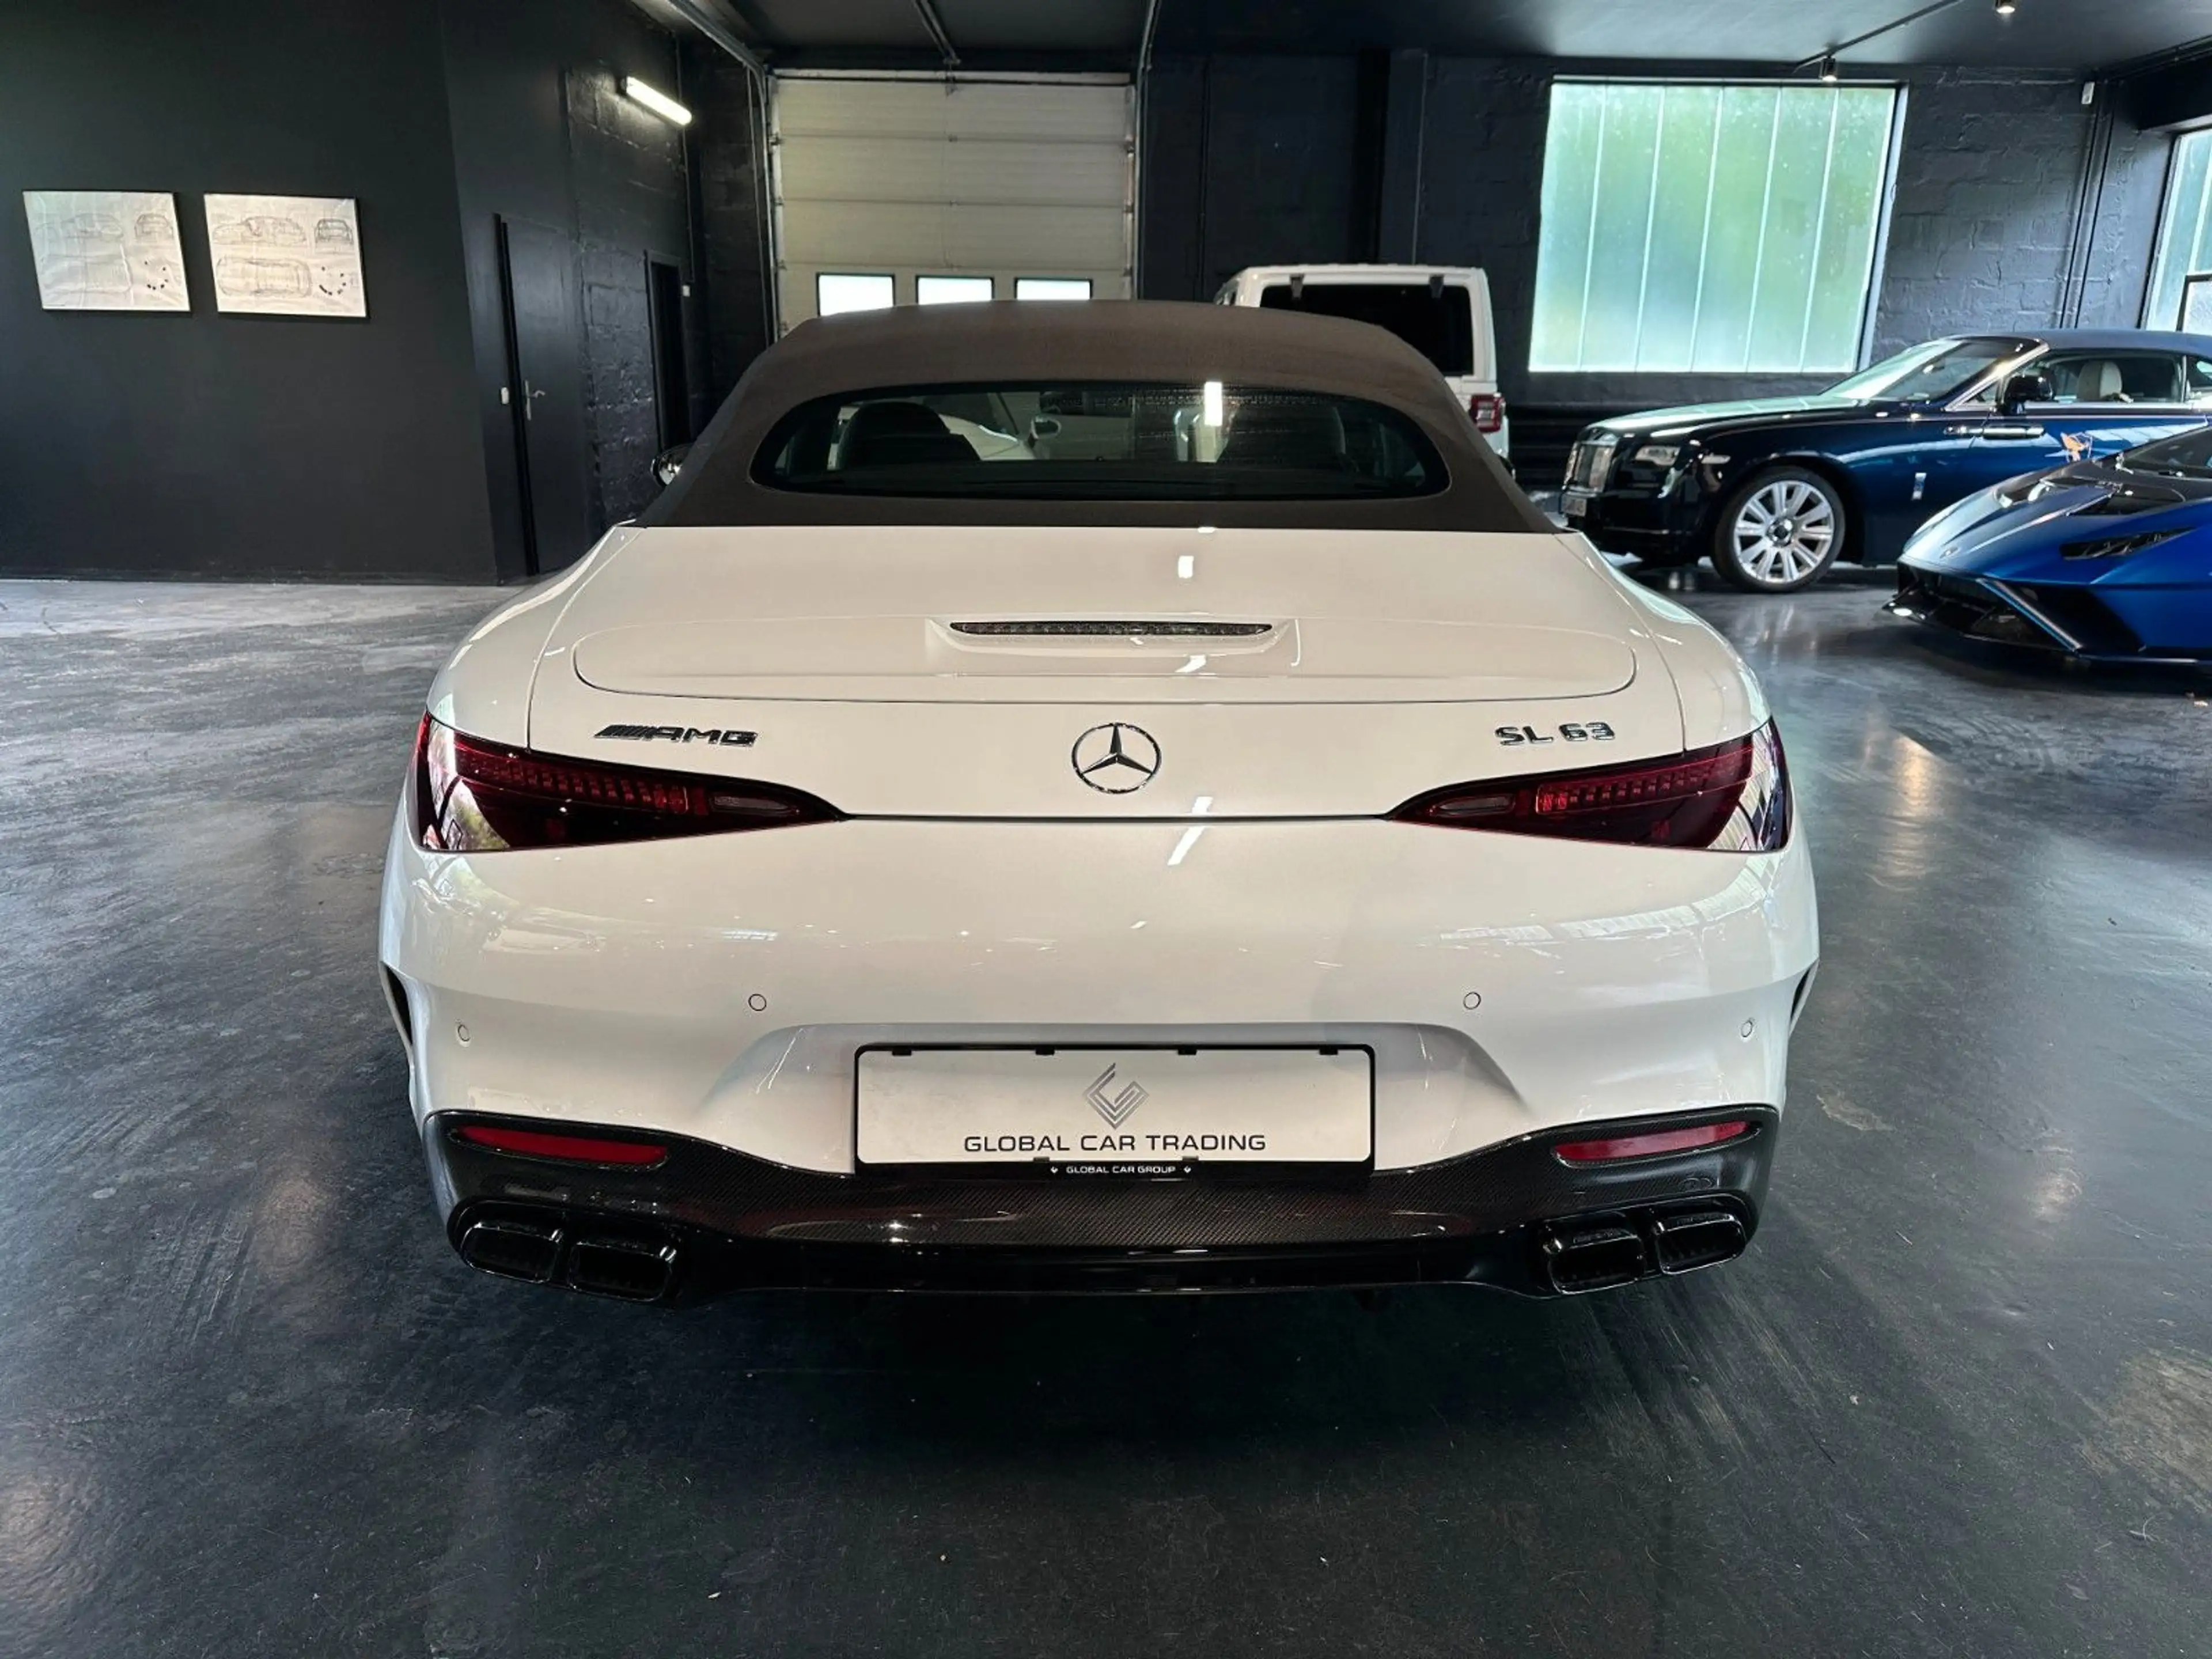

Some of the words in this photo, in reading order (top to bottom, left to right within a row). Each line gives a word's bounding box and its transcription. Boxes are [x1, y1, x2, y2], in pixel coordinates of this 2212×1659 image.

[639, 724, 757, 747] AMG
[1495, 726, 1554, 745] SL
[1559, 722, 1615, 741] 63
[964, 1135, 1070, 1152] GLOBAL
[1081, 1135, 1136, 1151] CAR
[1146, 1134, 1266, 1151] TRADING
[1066, 1165, 1110, 1174] GLOBAL
[1112, 1165, 1135, 1174] CAR
[1138, 1165, 1176, 1173] GROUP
